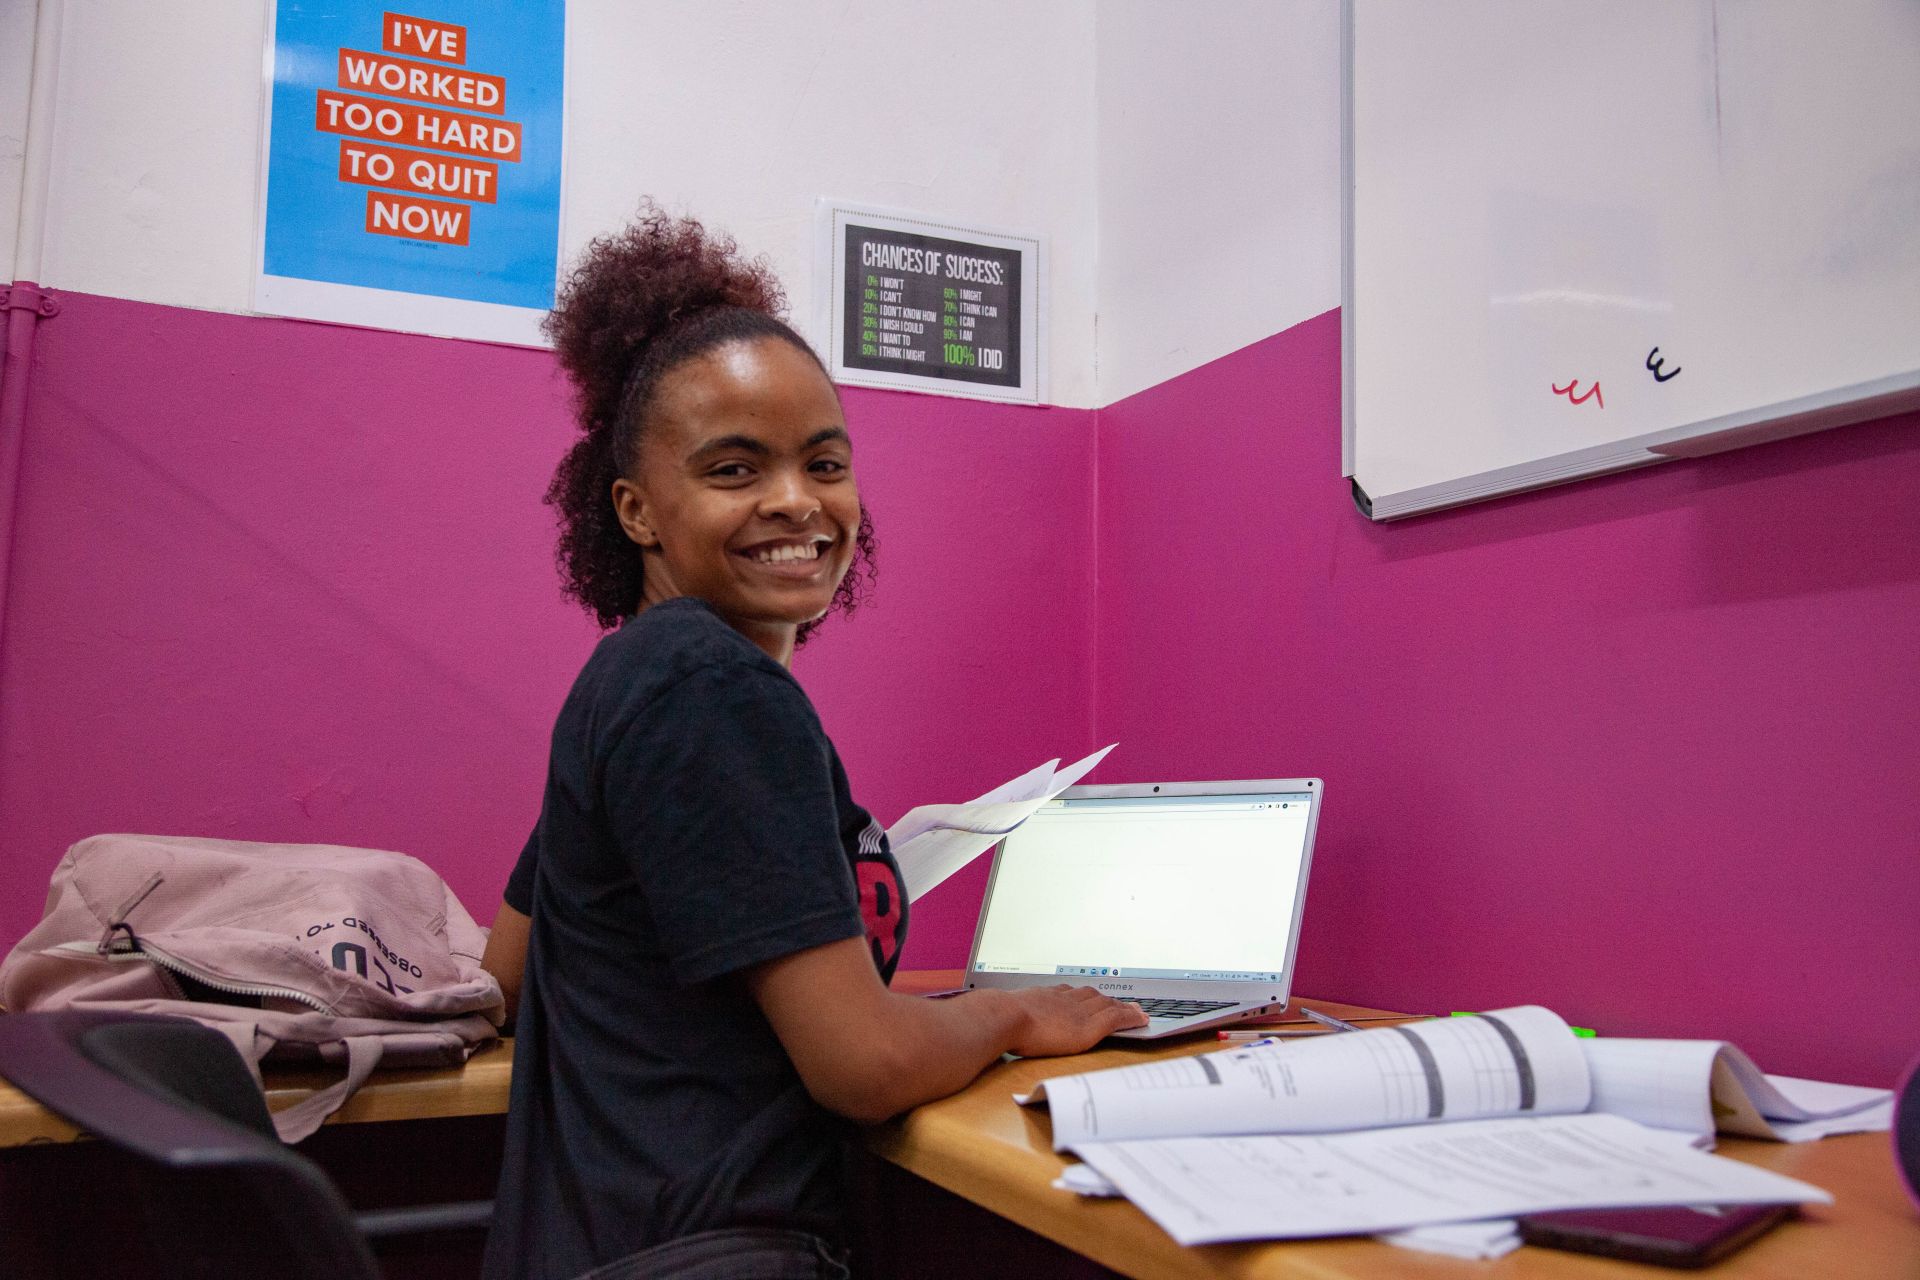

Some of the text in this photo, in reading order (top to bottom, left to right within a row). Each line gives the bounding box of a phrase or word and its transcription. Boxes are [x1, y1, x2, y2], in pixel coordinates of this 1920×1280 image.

[392, 21, 458, 57] I'VE
[345, 56, 500, 107] WORKED
[324, 98, 516, 154] TOO HARD
[346, 149, 492, 196] TO QUIT
[373, 200, 462, 238] NOW
[862, 242, 1003, 286] CHANCES OF SUCCESS:
[867, 274, 878, 287] 0%
[884, 277, 904, 290] WON'T
[864, 288, 878, 300] 10%
[884, 291, 902, 304] CAN'T
[963, 289, 982, 302] MIGHT
[863, 302, 878, 314] 20%
[884, 305, 902, 318] DON'T
[903, 307, 921, 320] KNOW
[922, 310, 937, 322] HOW
[963, 303, 980, 315] THINK
[985, 306, 997, 318] CAN
[883, 318, 899, 331] WISH
[904, 322, 924, 334] COULD
[963, 316, 975, 328] CAN
[883, 332, 901, 345] WANT
[902, 334, 910, 346] TO
[963, 330, 972, 342] AM
[883, 346, 902, 359] THINK
[906, 349, 926, 362] MIGHT
[943, 343, 1002, 370] 100% I DID
[306, 922, 335, 938] TO
